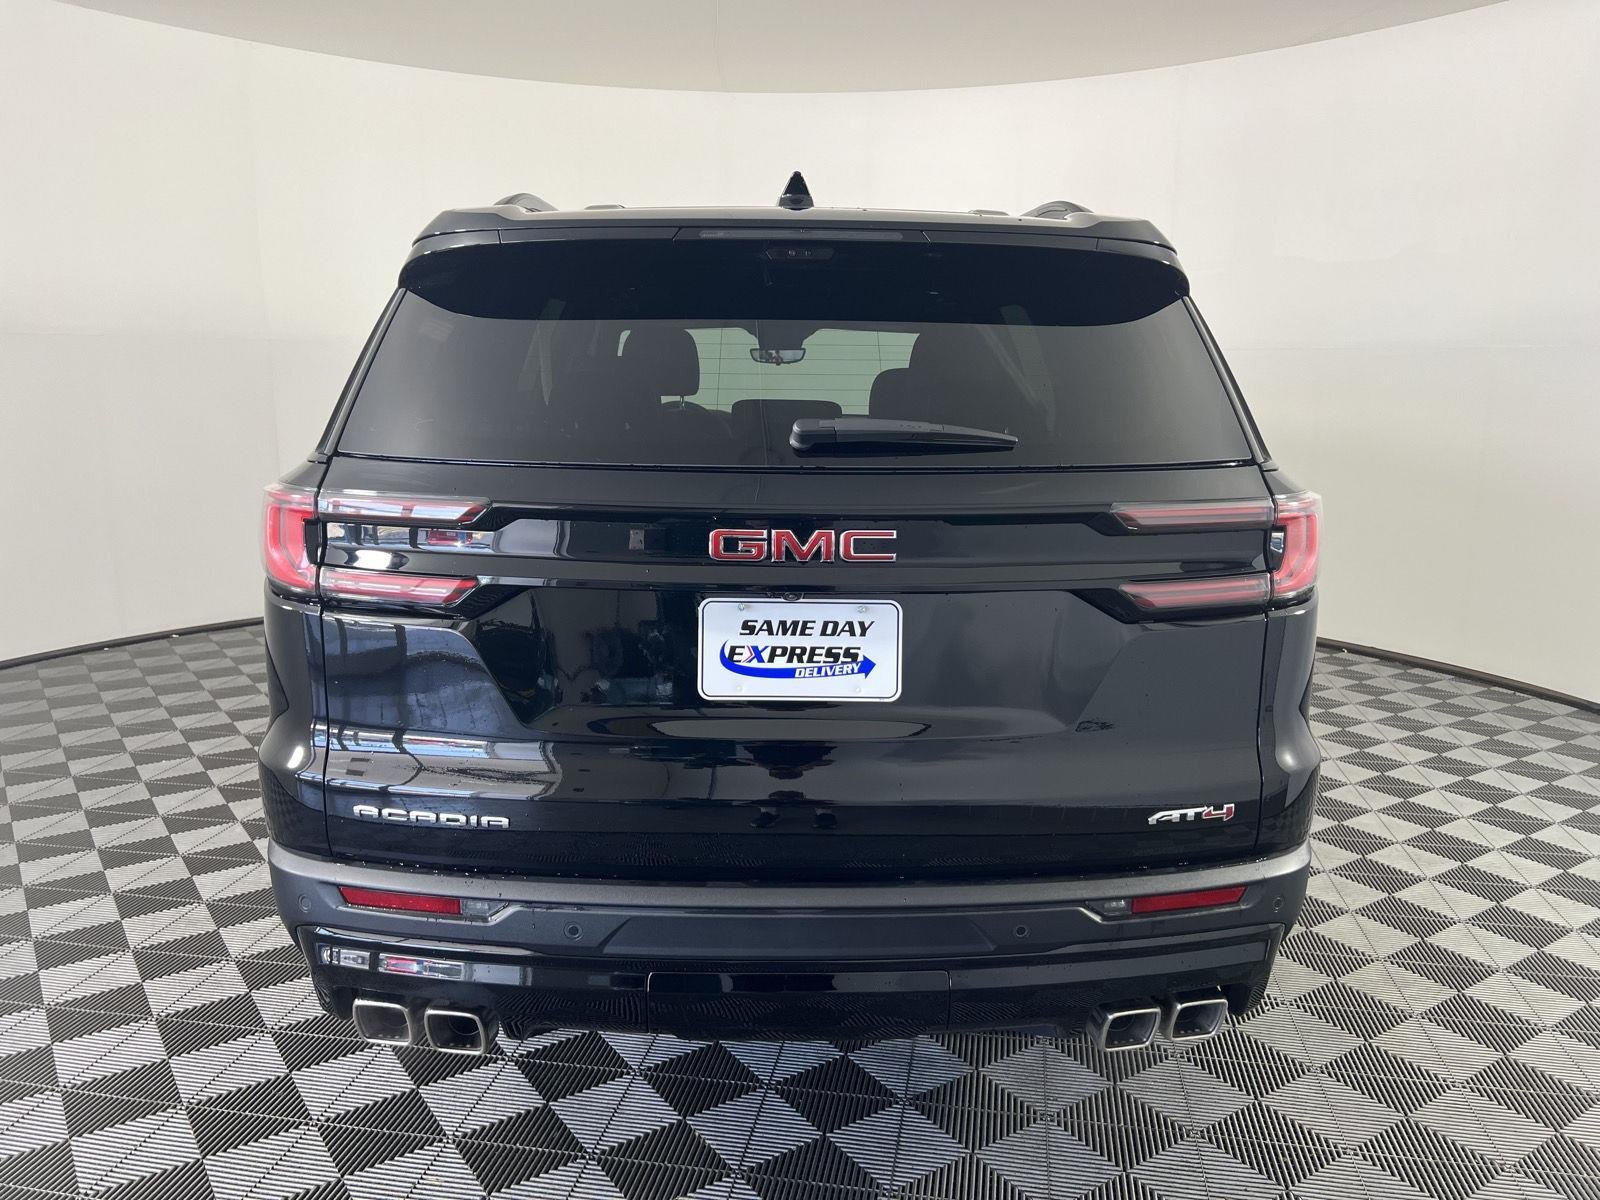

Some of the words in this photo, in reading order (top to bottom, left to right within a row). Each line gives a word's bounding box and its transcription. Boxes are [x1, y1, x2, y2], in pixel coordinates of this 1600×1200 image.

[709, 528, 897, 562] GMC
[739, 619, 816, 637] SAME
[819, 620, 876, 637] DAY
[727, 645, 861, 664] EXPRESS
[794, 662, 862, 678] DELIVERY
[352, 804, 510, 828] ACADIA
[1147, 803, 1235, 825] AT4
